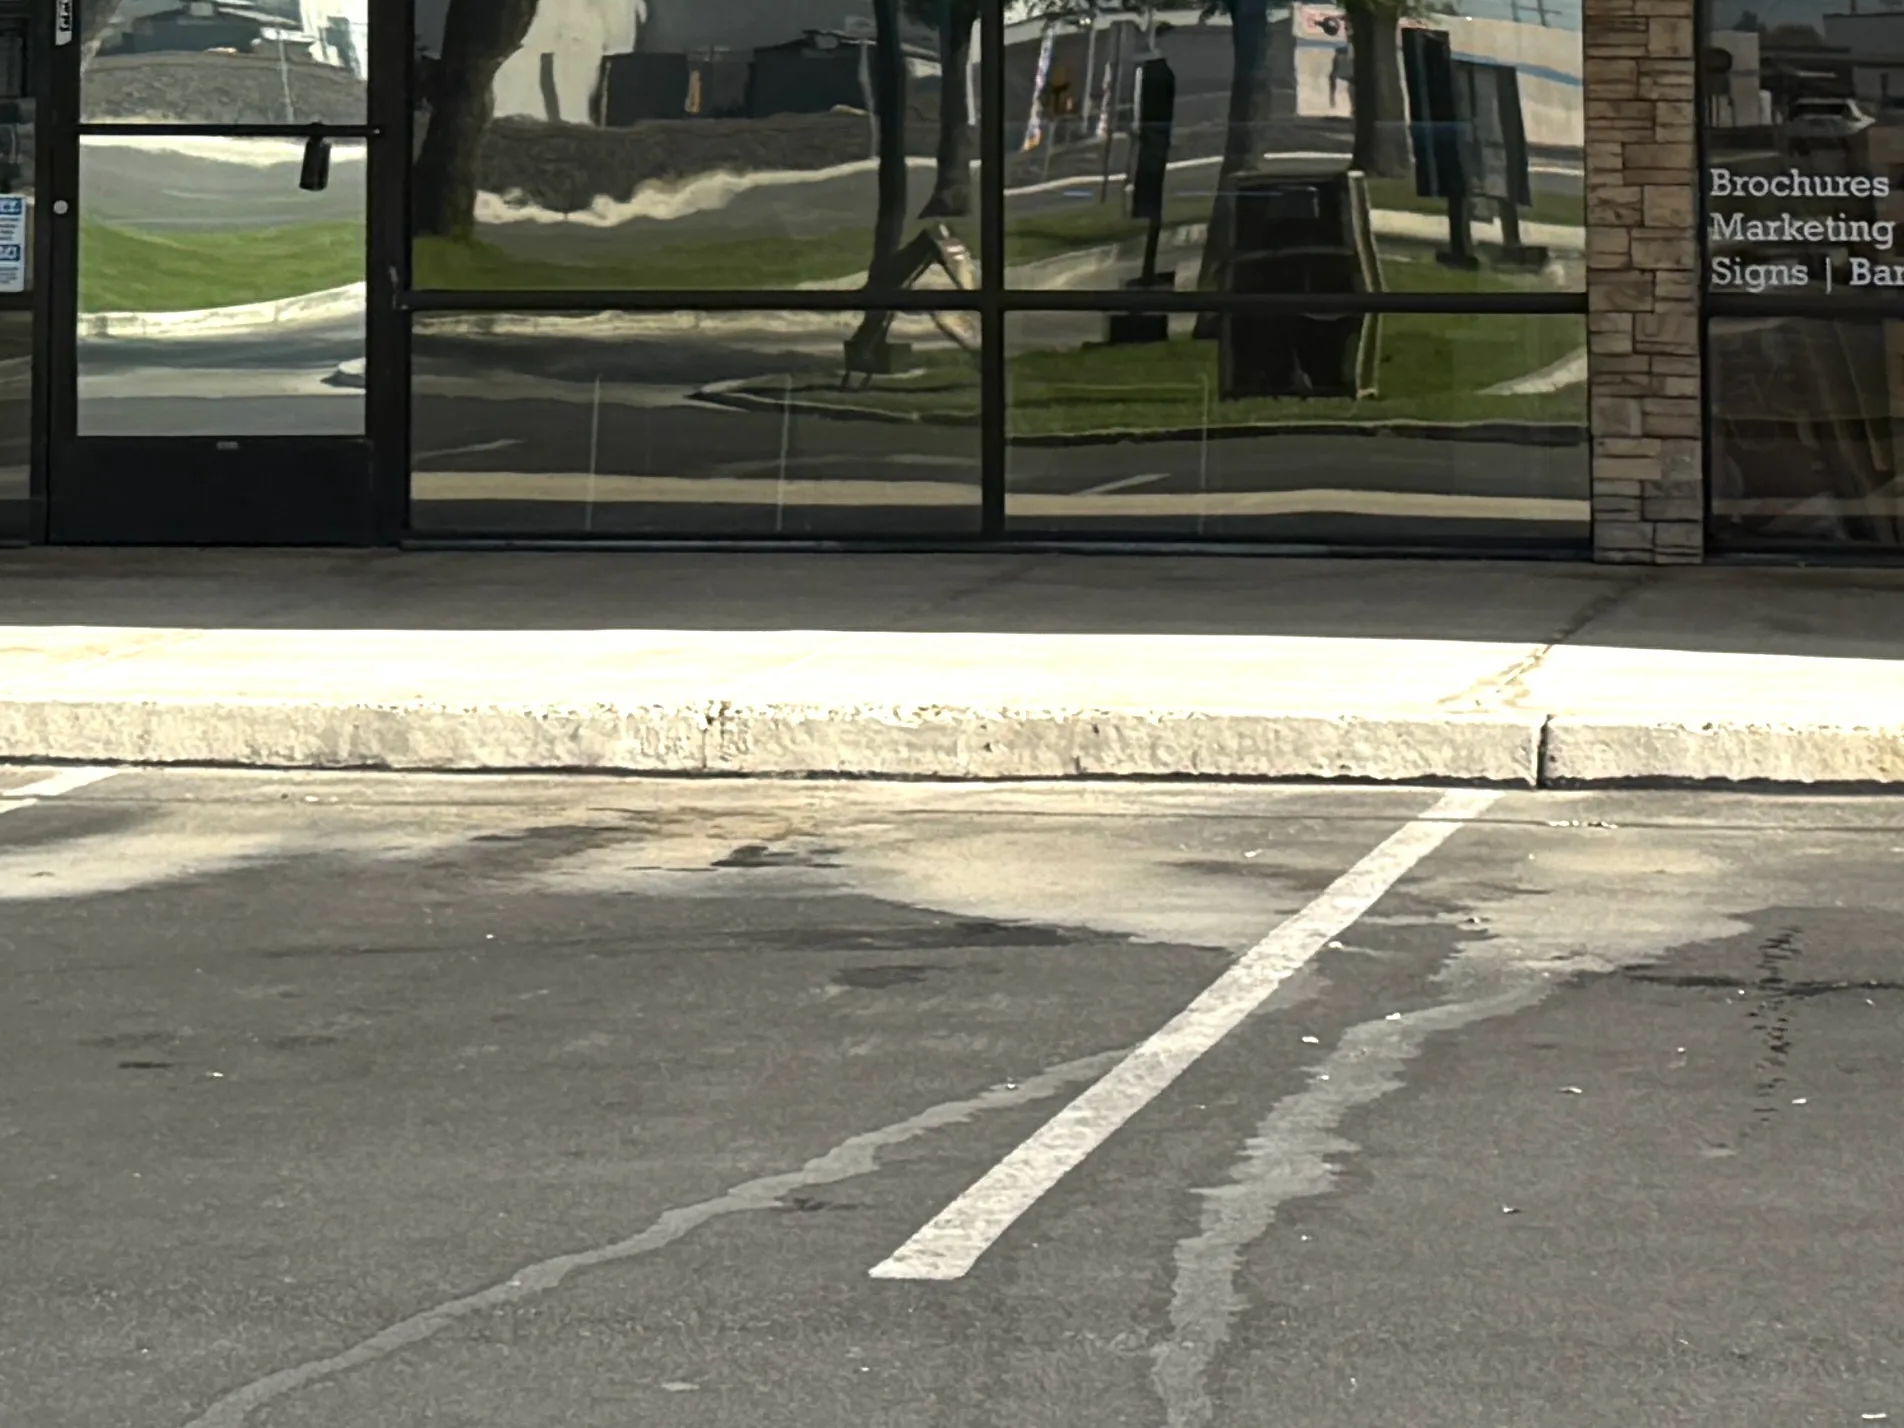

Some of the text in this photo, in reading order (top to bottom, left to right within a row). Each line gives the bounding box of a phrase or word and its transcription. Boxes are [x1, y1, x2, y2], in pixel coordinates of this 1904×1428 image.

[1710, 168, 1889, 197] Brochures
[1710, 212, 1895, 250] Marketing
[1711, 256, 1808, 293] Signs
